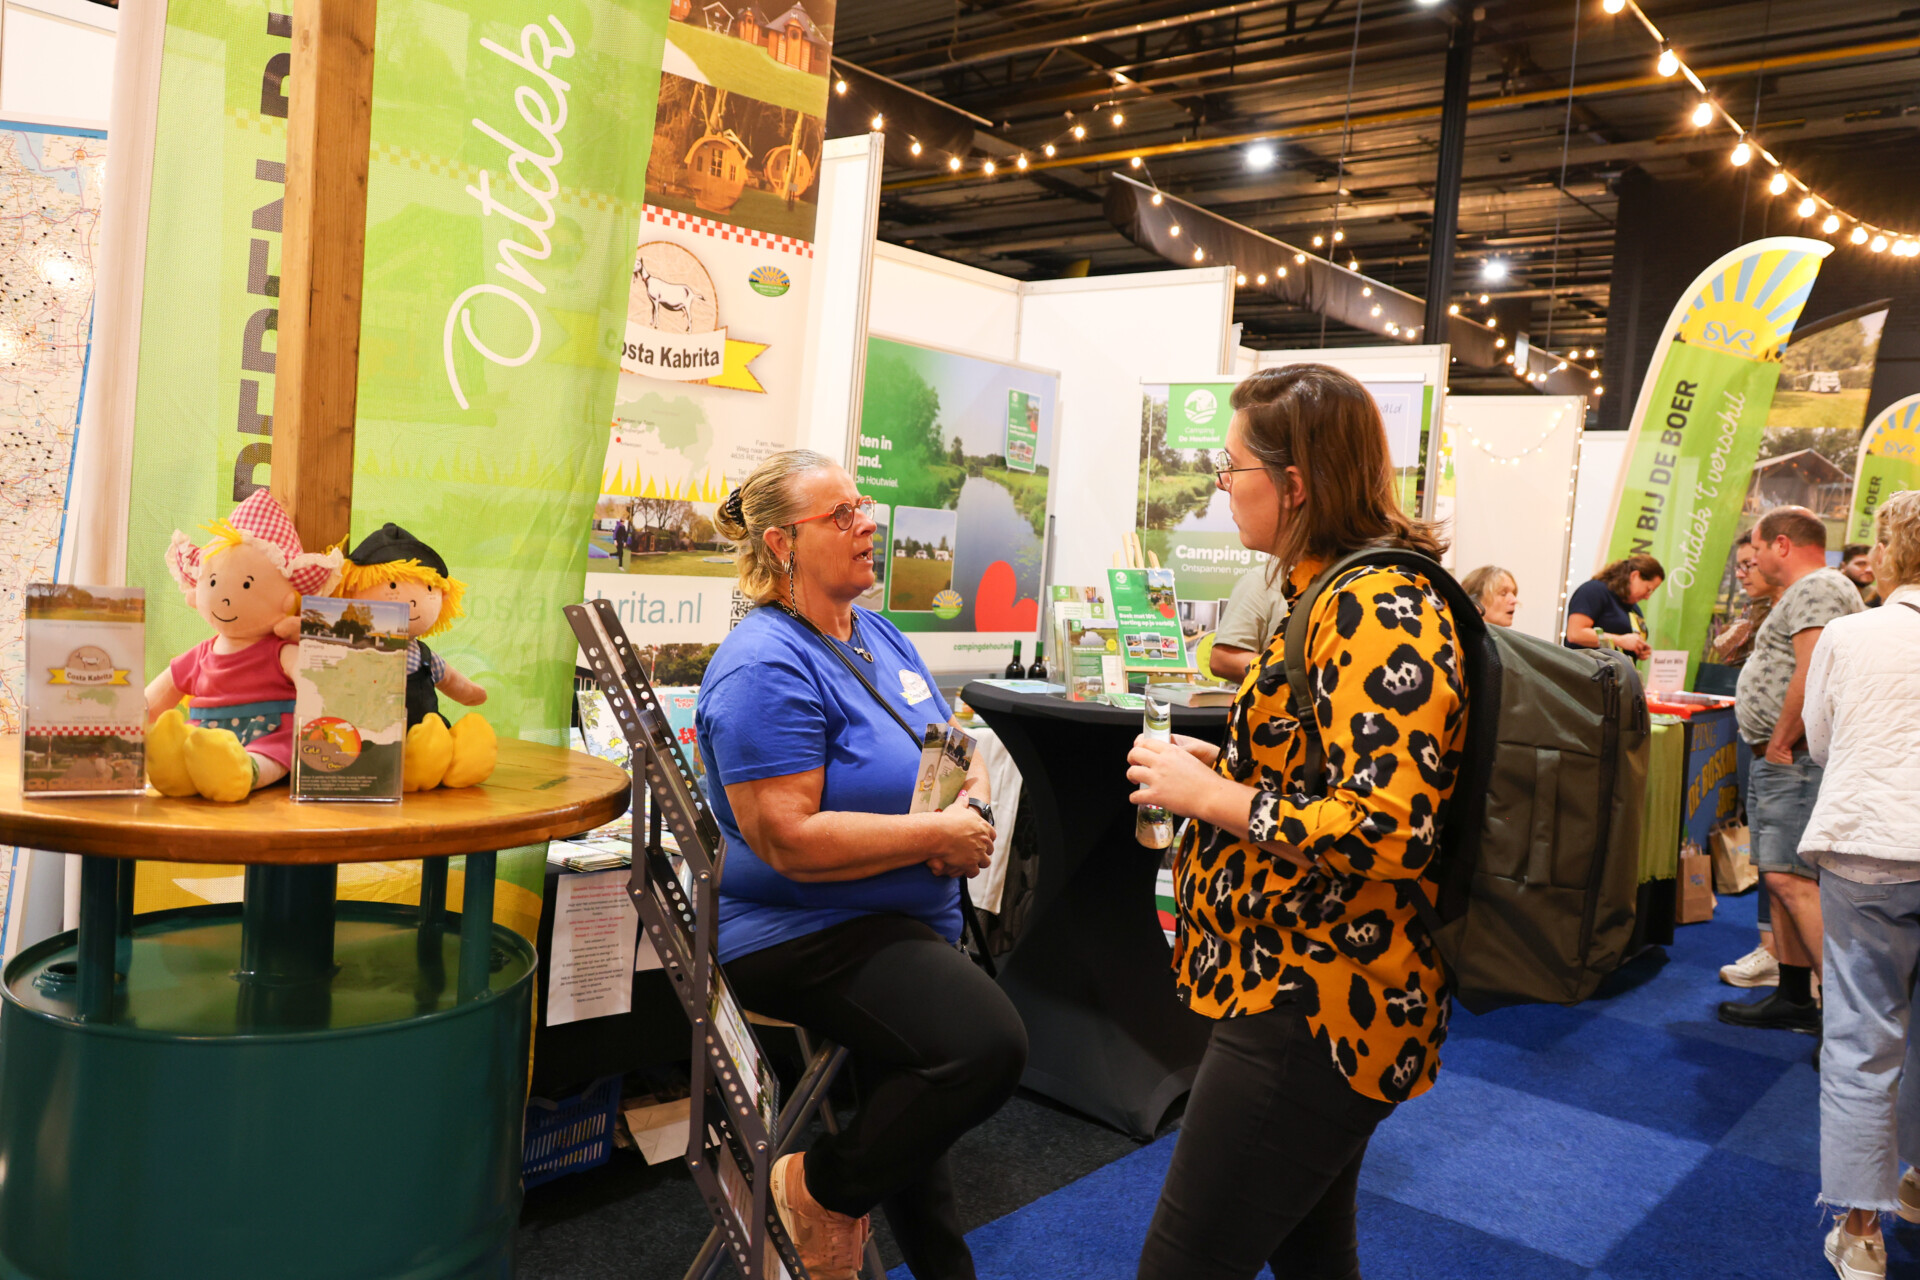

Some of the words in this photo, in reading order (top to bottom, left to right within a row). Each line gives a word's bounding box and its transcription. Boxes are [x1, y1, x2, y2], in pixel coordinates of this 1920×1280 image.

[443, 14, 576, 410] Ontdek
[1703, 320, 1756, 351] SVR
[660, 346, 720, 369] Kabrita
[1660, 380, 1699, 447] BOER
[860, 434, 880, 450] ten
[881, 435, 893, 451] in
[857, 454, 882, 469] and.
[1649, 452, 1677, 486] DE
[1667, 507, 1712, 598] Ontdek
[1707, 390, 1746, 483] verschil
[1636, 491, 1665, 532] BIJ
[1175, 544, 1251, 566] Camping
[1181, 563, 1232, 576] Ontspannen
[953, 642, 1014, 653] campingdehoutwie
[66, 671, 87, 681] Costa
[1690, 721, 1717, 752] PING
